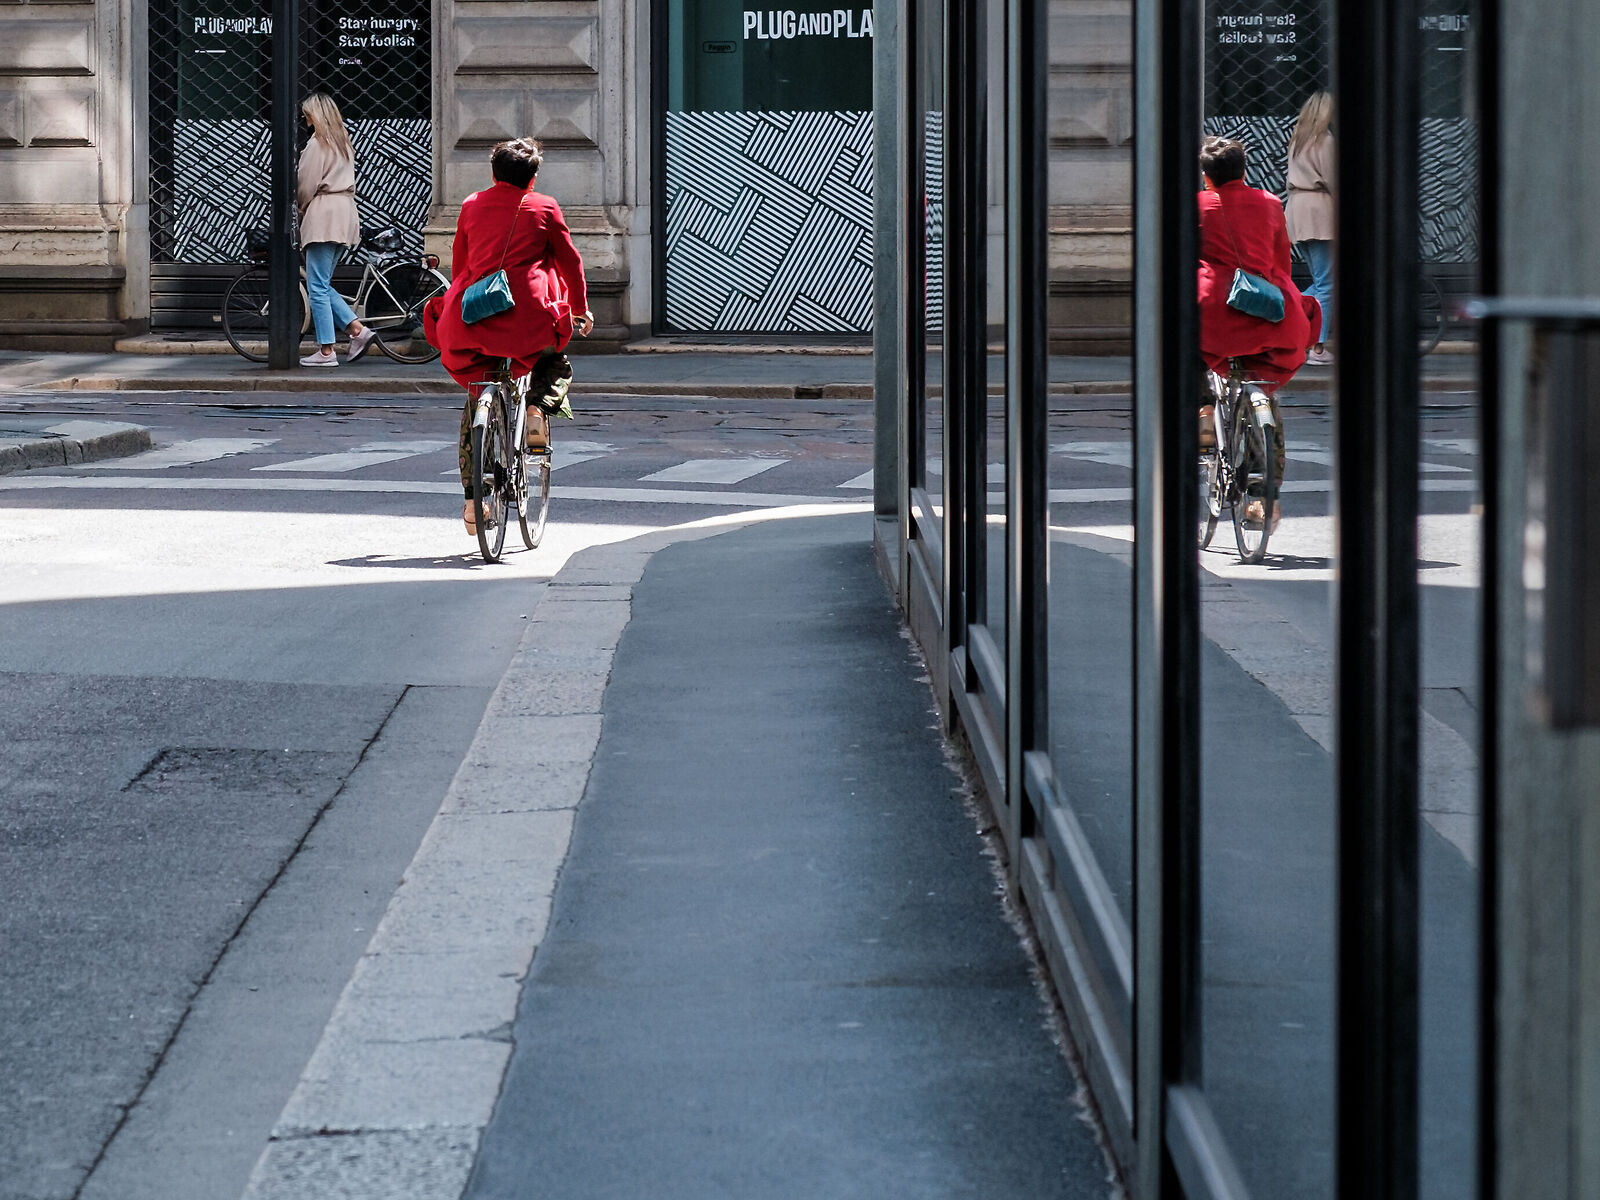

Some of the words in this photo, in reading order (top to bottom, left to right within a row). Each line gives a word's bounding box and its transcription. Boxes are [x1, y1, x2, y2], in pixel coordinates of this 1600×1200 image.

[339, 17, 367, 31] Stay
[743, 9, 874, 40] PLUGANDPLA
[339, 35, 367, 48] Stay
[370, 34, 415, 47] foolish
